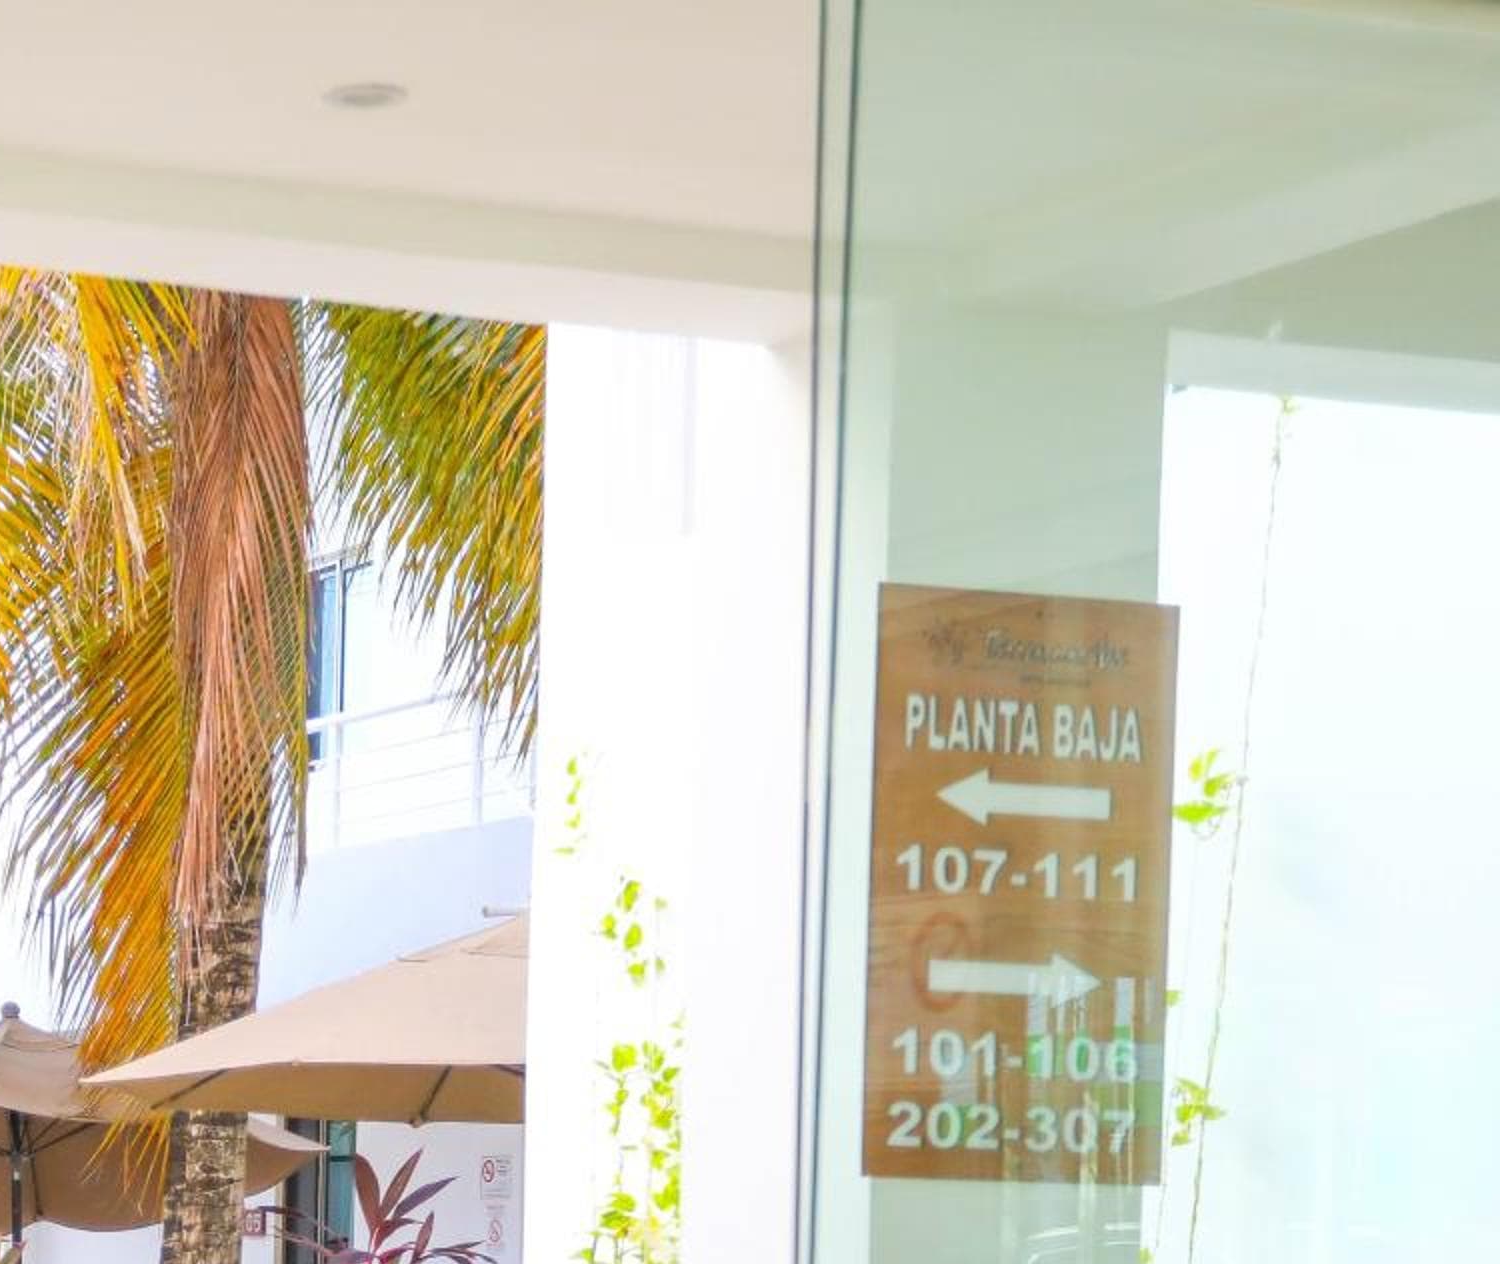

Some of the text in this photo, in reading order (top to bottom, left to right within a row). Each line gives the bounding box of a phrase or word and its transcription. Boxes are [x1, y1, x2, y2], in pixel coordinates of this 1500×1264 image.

[906, 694, 1142, 763] PLANTA BAJA
[896, 843, 1137, 903] 107-111
[891, 1027, 1138, 1082] 101-106
[885, 1099, 1137, 1154] 202-307
